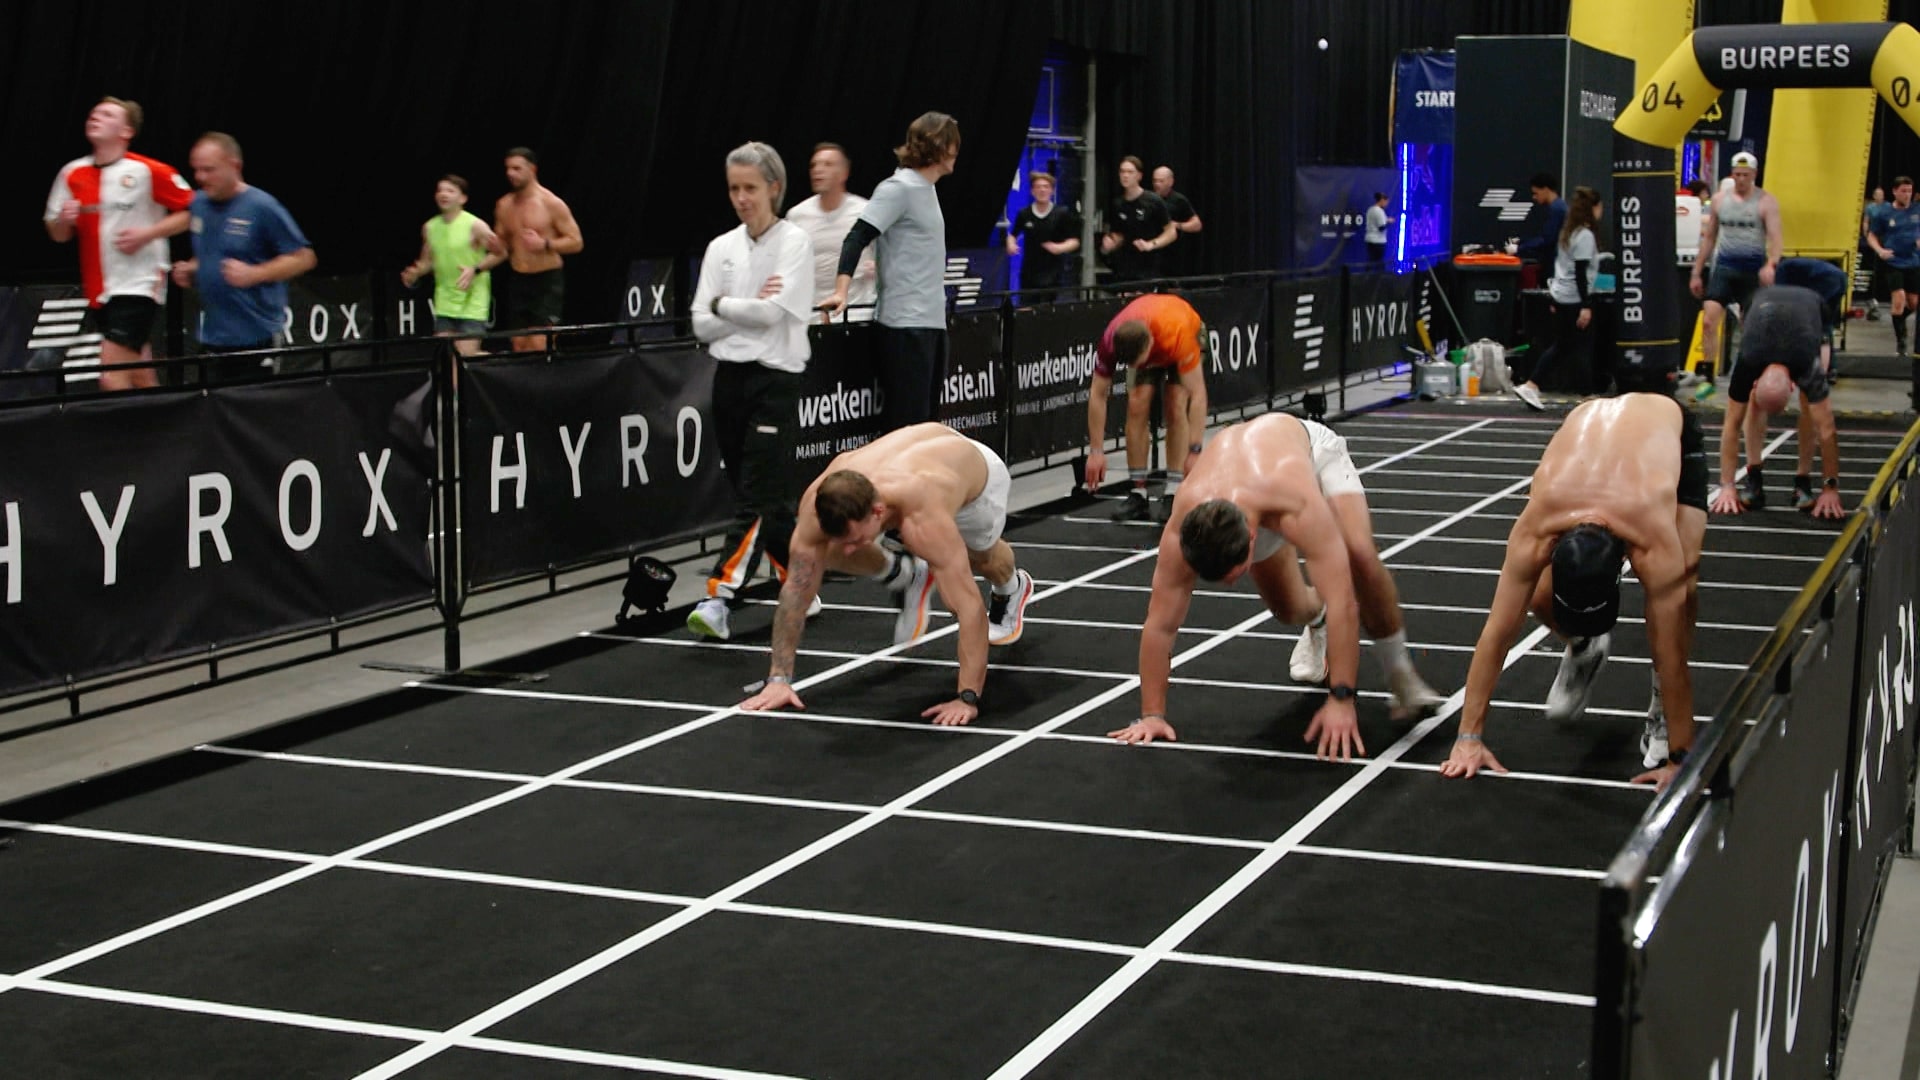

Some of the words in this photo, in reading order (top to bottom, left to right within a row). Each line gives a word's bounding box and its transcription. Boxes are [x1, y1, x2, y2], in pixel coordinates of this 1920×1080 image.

[1720, 44, 1850, 70] BURPEES
[1415, 90, 1456, 107] START
[1642, 81, 1684, 113] 04
[1891, 76, 1920, 108] 0
[1321, 214, 1364, 226] HYRO
[1621, 196, 1642, 323] BURPEES
[1352, 301, 1409, 344] HYROX
[1208, 323, 1260, 375] ROX
[1017, 342, 1100, 390] werkenbijd
[490, 405, 725, 513] HYRO
[795, 440, 831, 461] MARINE
